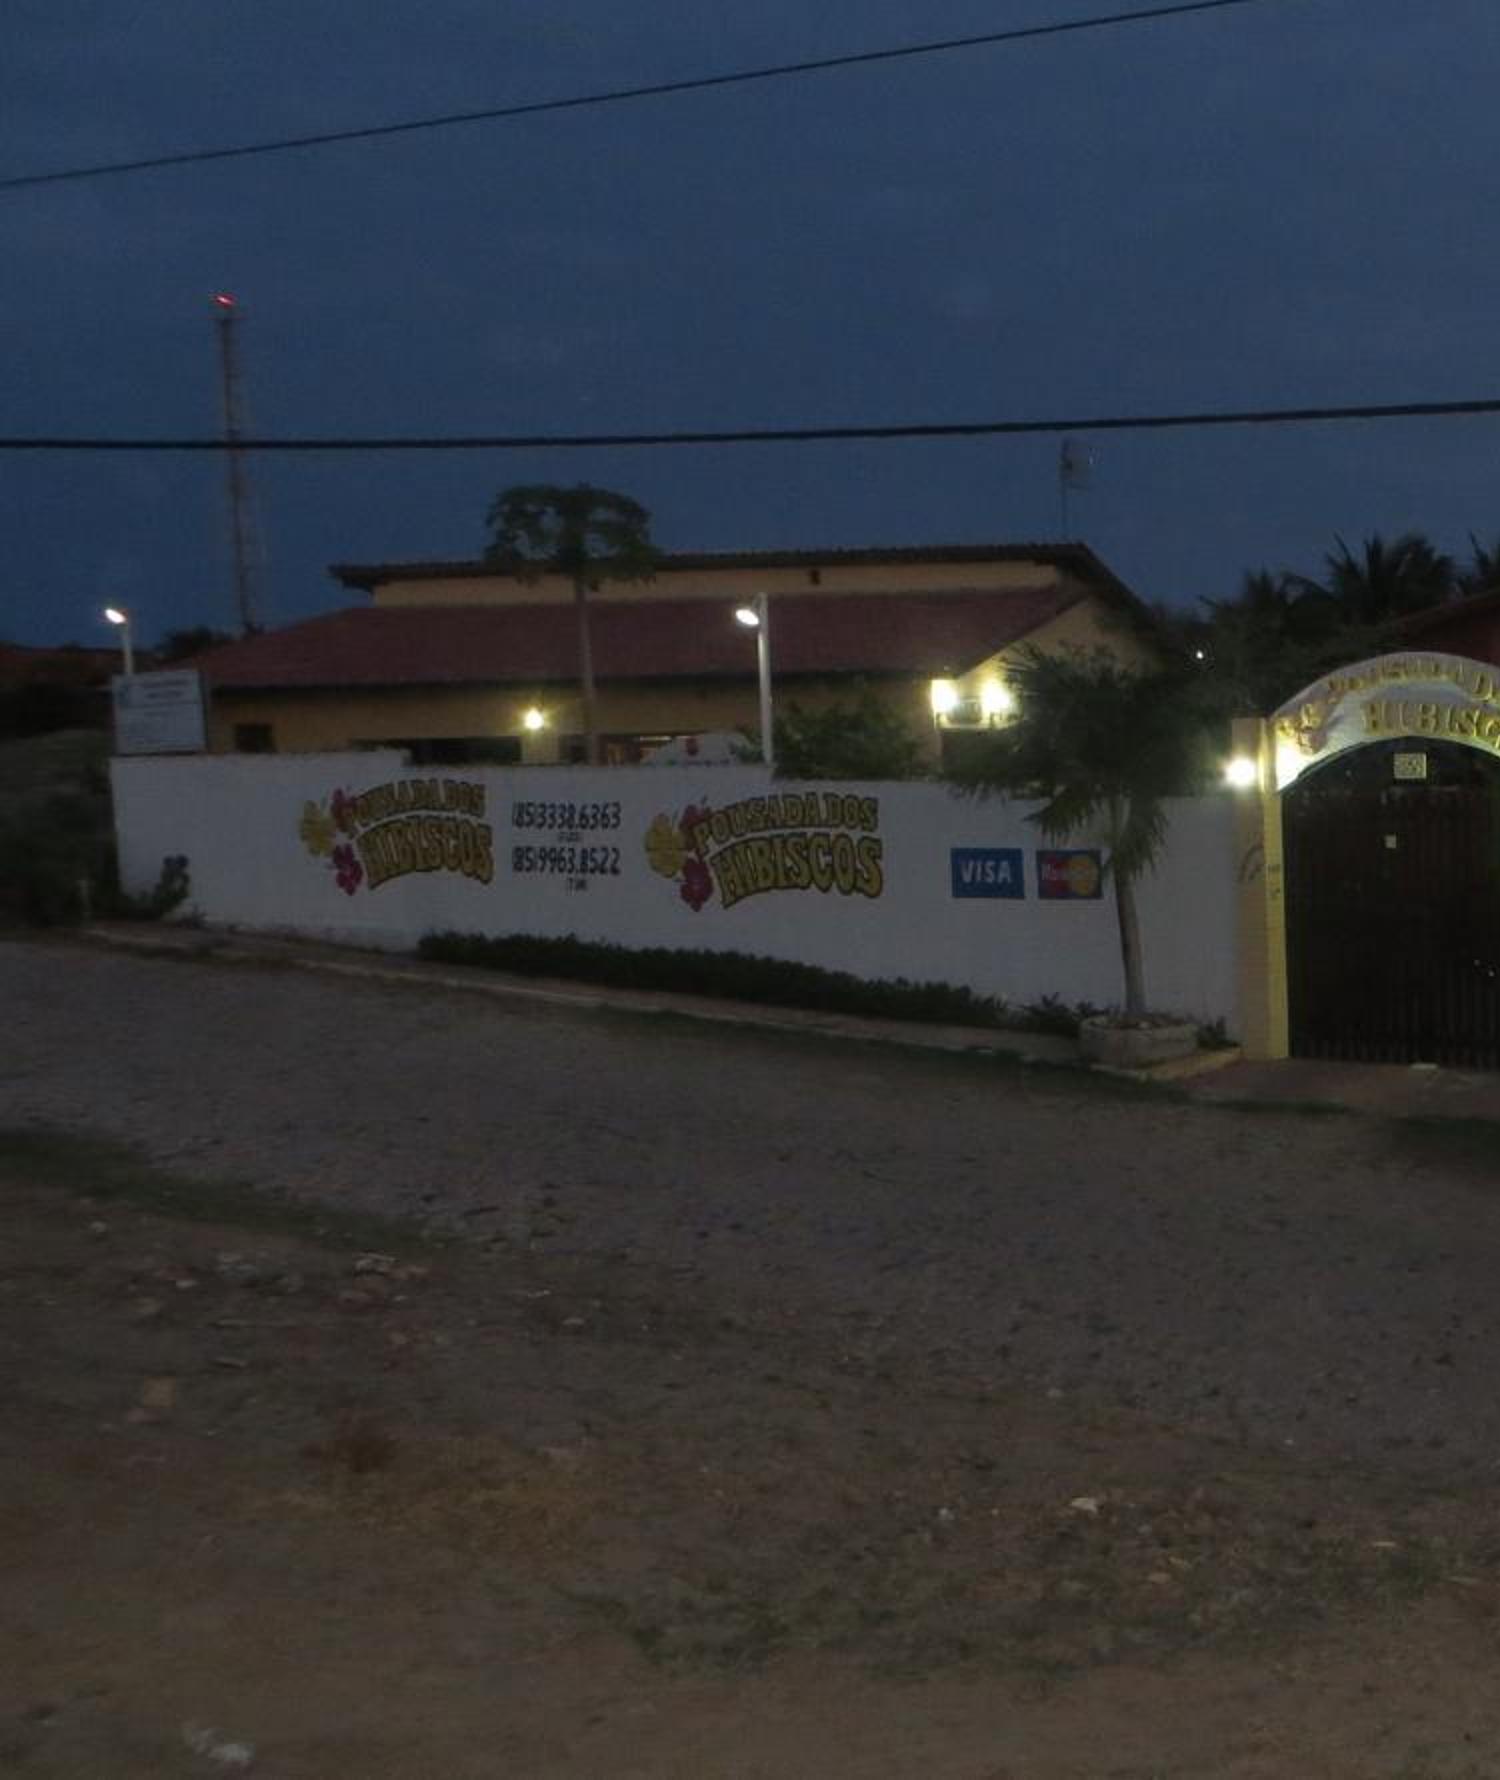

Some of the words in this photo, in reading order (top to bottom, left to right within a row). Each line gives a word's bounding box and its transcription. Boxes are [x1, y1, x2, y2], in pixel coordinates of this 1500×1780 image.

[356, 813, 494, 890] HIBISCOS
[692, 791, 822, 856] POUSADA
[822, 791, 879, 833] DOS
[709, 832, 883, 910] HIBISCOS
[960, 858, 1012, 884] VISA
